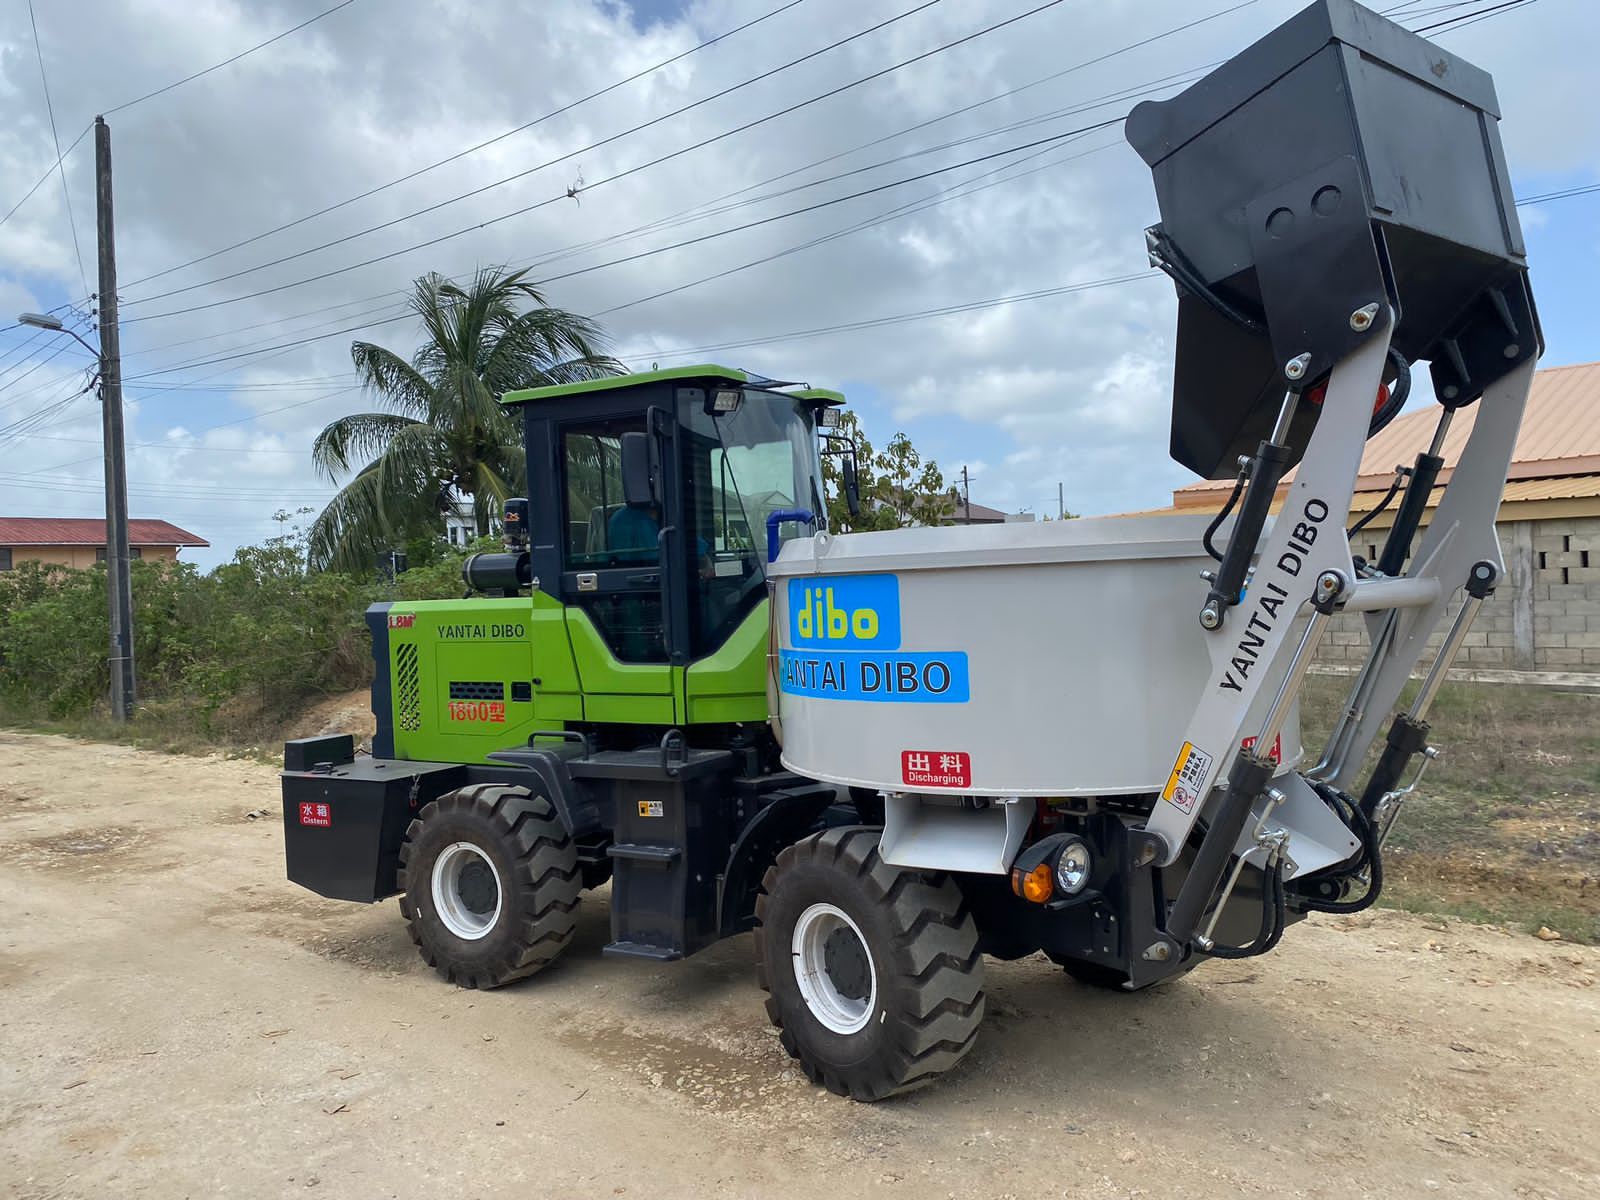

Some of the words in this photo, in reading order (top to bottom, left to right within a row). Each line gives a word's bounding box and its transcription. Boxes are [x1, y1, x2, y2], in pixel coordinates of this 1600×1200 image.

[1220, 581, 1289, 693] YANTAI
[1276, 498, 1329, 577] DIBO
[798, 588, 879, 639] dibo
[438, 625, 486, 638] YANTAI
[492, 624, 525, 638] DIBO
[783, 656, 847, 692] ANTAI
[861, 661, 951, 695] DIBO
[908, 754, 963, 773] 出料
[908, 772, 964, 786] Discharging
[303, 816, 328, 825] Cistern
